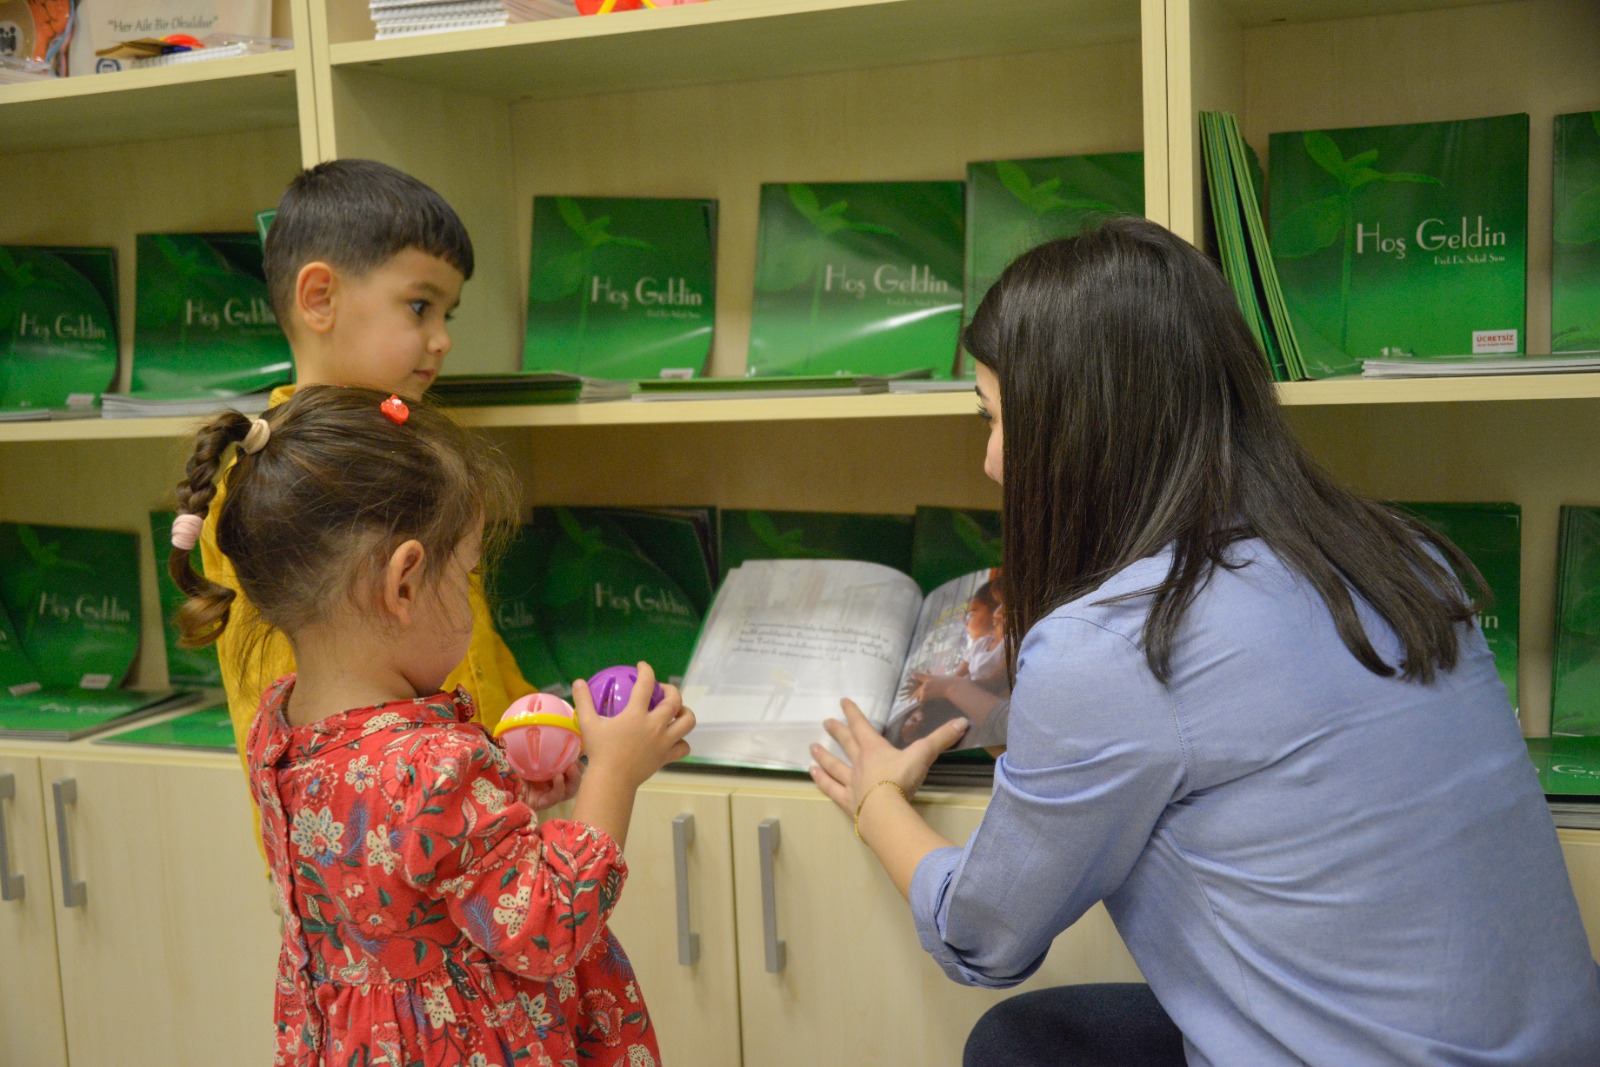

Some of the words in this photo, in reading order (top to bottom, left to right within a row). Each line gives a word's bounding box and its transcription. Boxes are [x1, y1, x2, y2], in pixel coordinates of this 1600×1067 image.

[1357, 223, 1406, 259] Hoş
[1416, 216, 1506, 250] Geldin
[592, 276, 629, 310] Hoş
[635, 276, 702, 305] Geldin
[824, 264, 866, 298] Hoş
[874, 264, 948, 293] Geldin
[55, 312, 105, 339] Geldin
[75, 594, 130, 622] Geldin
[634, 584, 689, 616] Geldin
